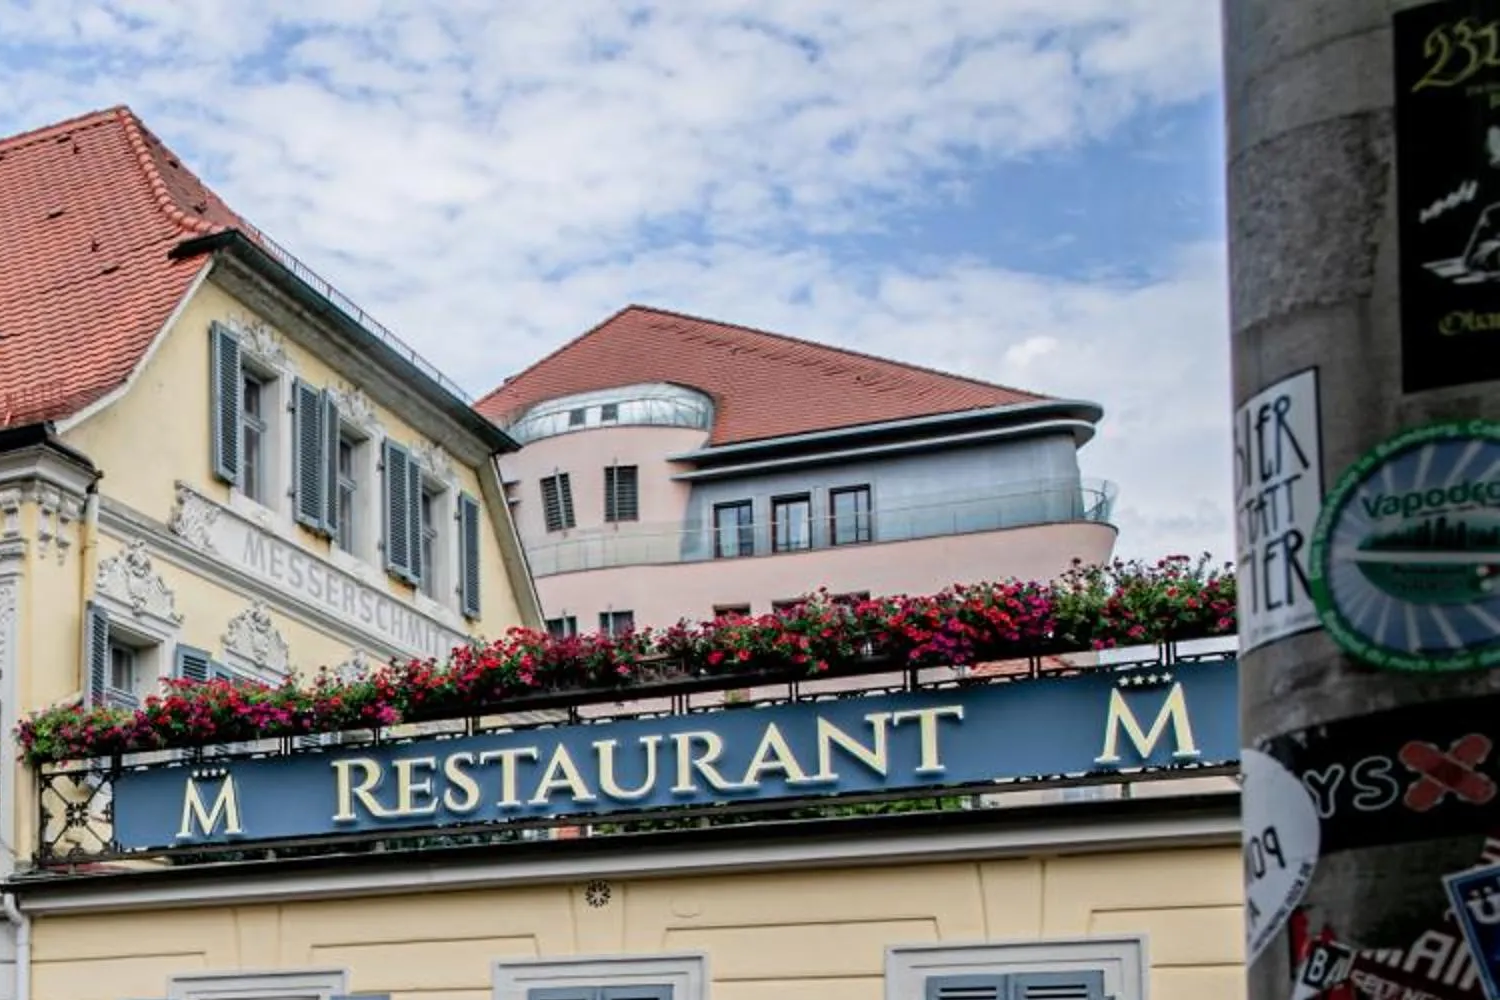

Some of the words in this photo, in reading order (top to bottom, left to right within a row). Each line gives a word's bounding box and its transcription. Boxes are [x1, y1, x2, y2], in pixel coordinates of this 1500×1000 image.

[243, 530, 455, 657] MESSERSCHMITT
[176, 772, 242, 839] M
[331, 704, 965, 824] RESTAURANT
[1093, 681, 1202, 766] M
